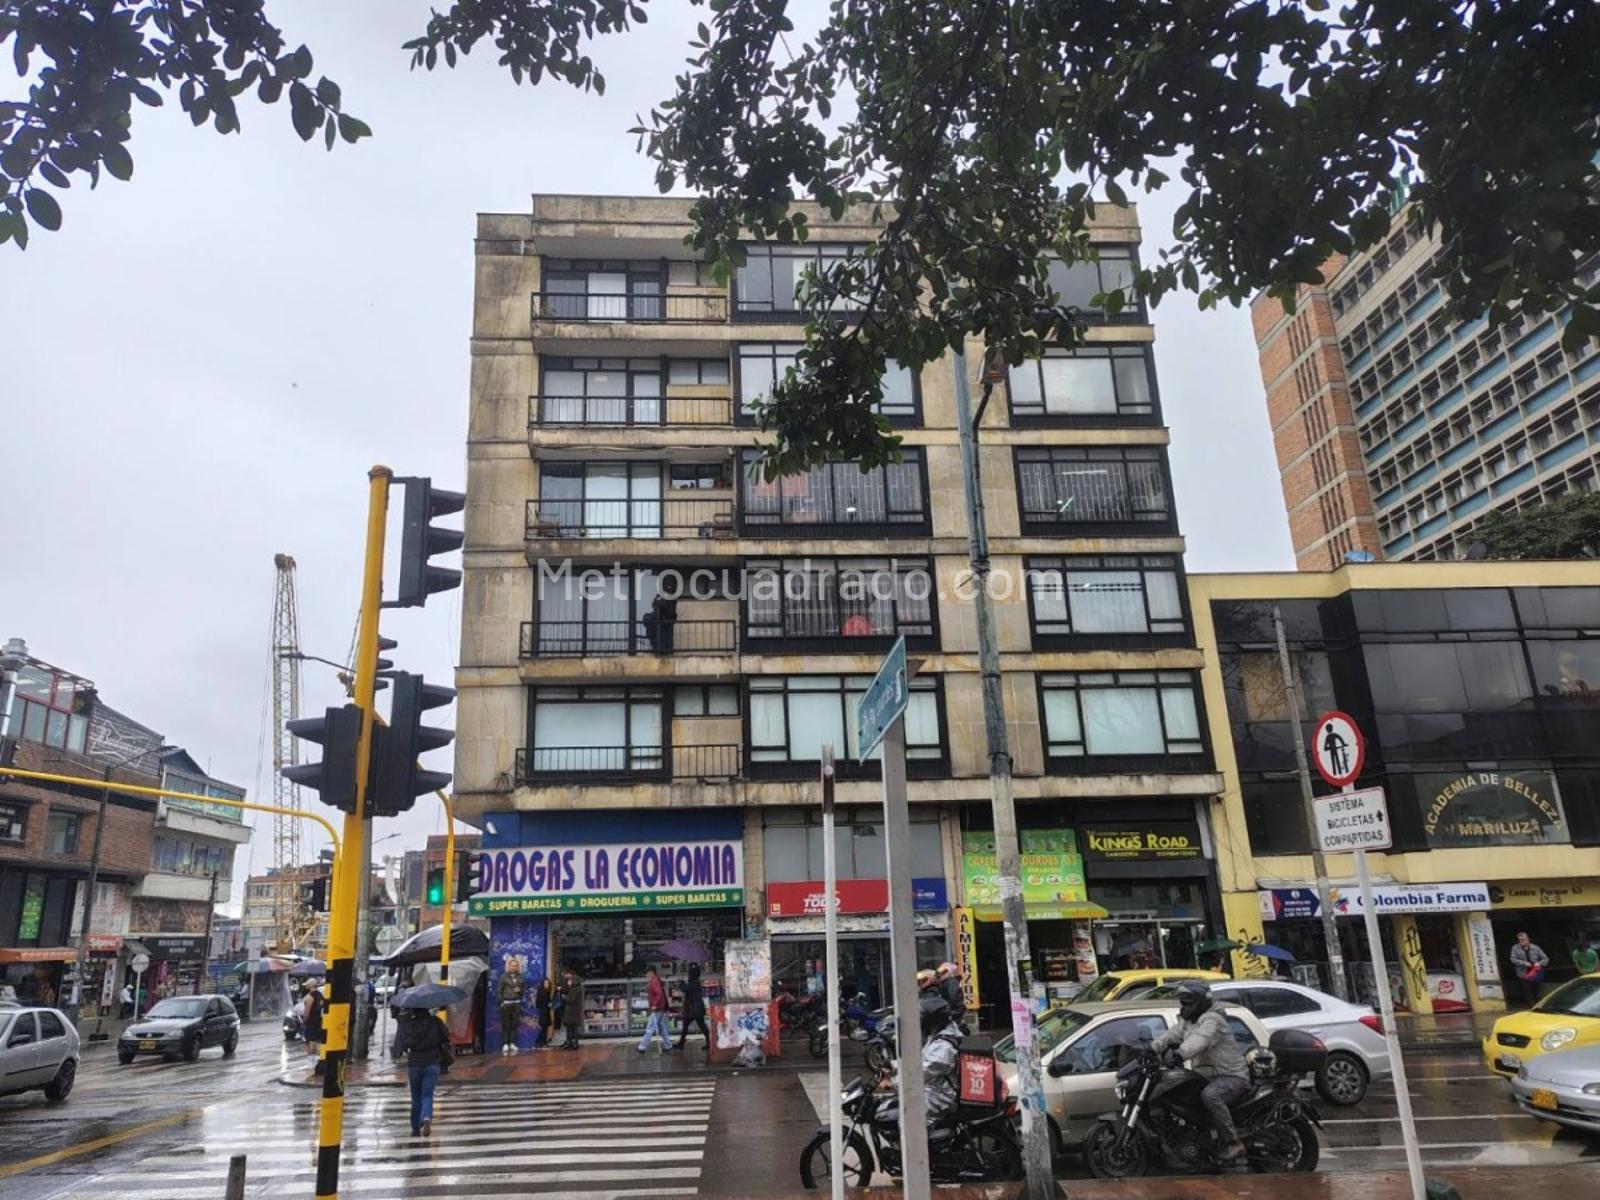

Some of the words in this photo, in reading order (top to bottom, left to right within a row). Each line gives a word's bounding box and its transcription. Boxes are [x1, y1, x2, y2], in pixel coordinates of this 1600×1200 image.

[1329, 798, 1364, 813] SISTEMA
[1424, 775, 1477, 836] ACADEMIA
[1480, 773, 1499, 785] DE
[1327, 813, 1375, 830] BICICLETAS
[1459, 821, 1531, 835] MARILUZ
[1146, 833, 1189, 848] ROAD
[1324, 830, 1384, 847] COMPARTIDAS
[479, 849, 575, 893] DROGAS
[584, 848, 609, 889] LA
[616, 844, 736, 889] ECONOMIA
[488, 901, 519, 910] SUPER
[521, 898, 562, 909] BARATAS
[580, 896, 637, 908] DROGUERIA
[655, 895, 686, 905] SUPER
[687, 892, 726, 903] BARATAS
[1436, 892, 1486, 904] Farma
[960, 913, 974, 1007] ALMUERZOS
